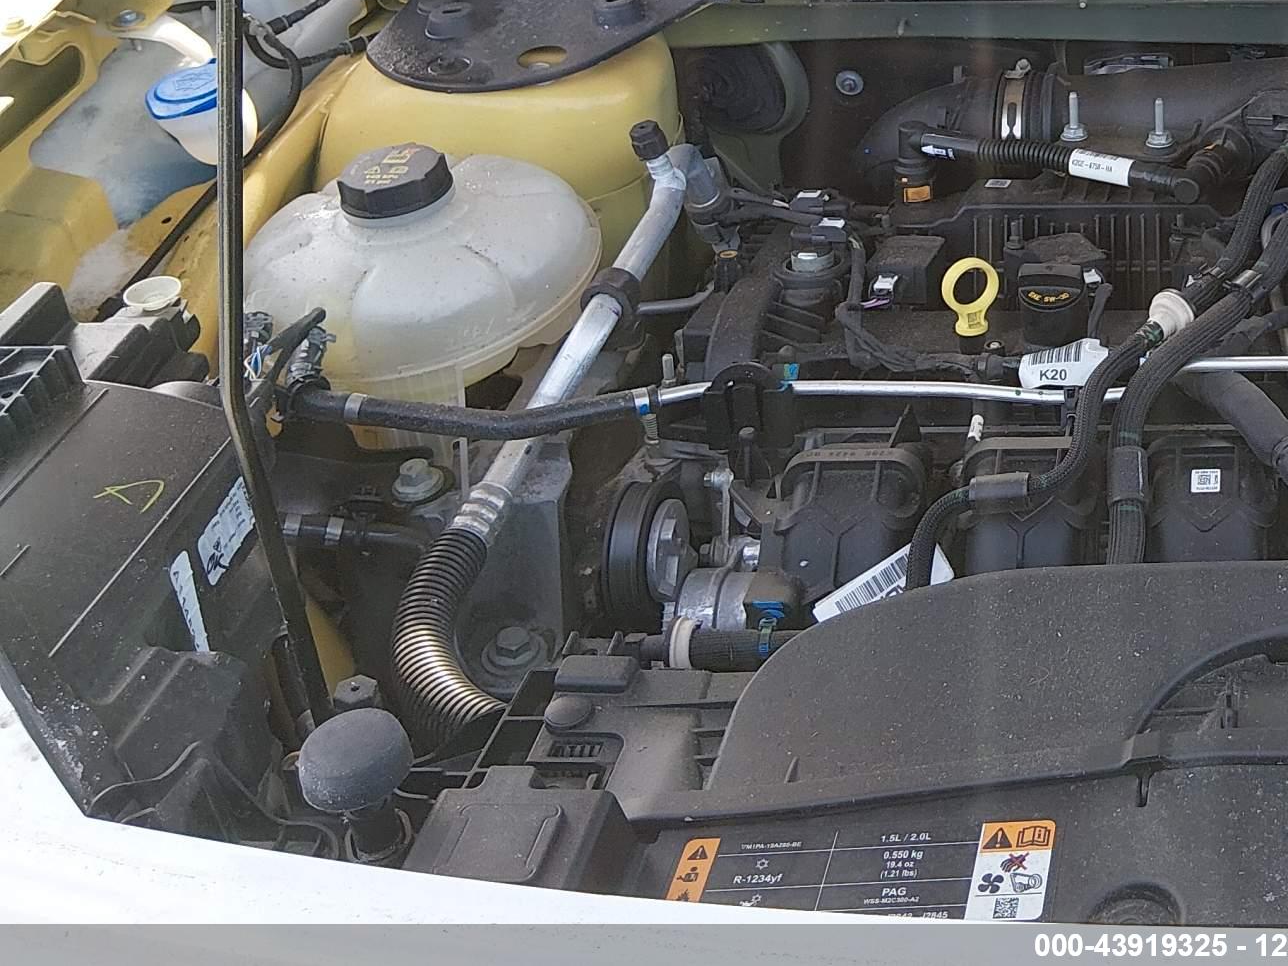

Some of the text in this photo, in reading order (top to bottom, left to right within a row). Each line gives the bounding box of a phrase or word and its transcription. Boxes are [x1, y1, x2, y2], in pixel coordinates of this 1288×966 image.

[1039, 369, 1067, 381] K20
[881, 834, 902, 843] 1.5L
[910, 833, 932, 841] 2.0L
[883, 849, 923, 860] 0.550 kg
[886, 860, 902, 869] 19.4
[733, 873, 783, 884] R-1234yf
[881, 887, 907, 897] PAG
